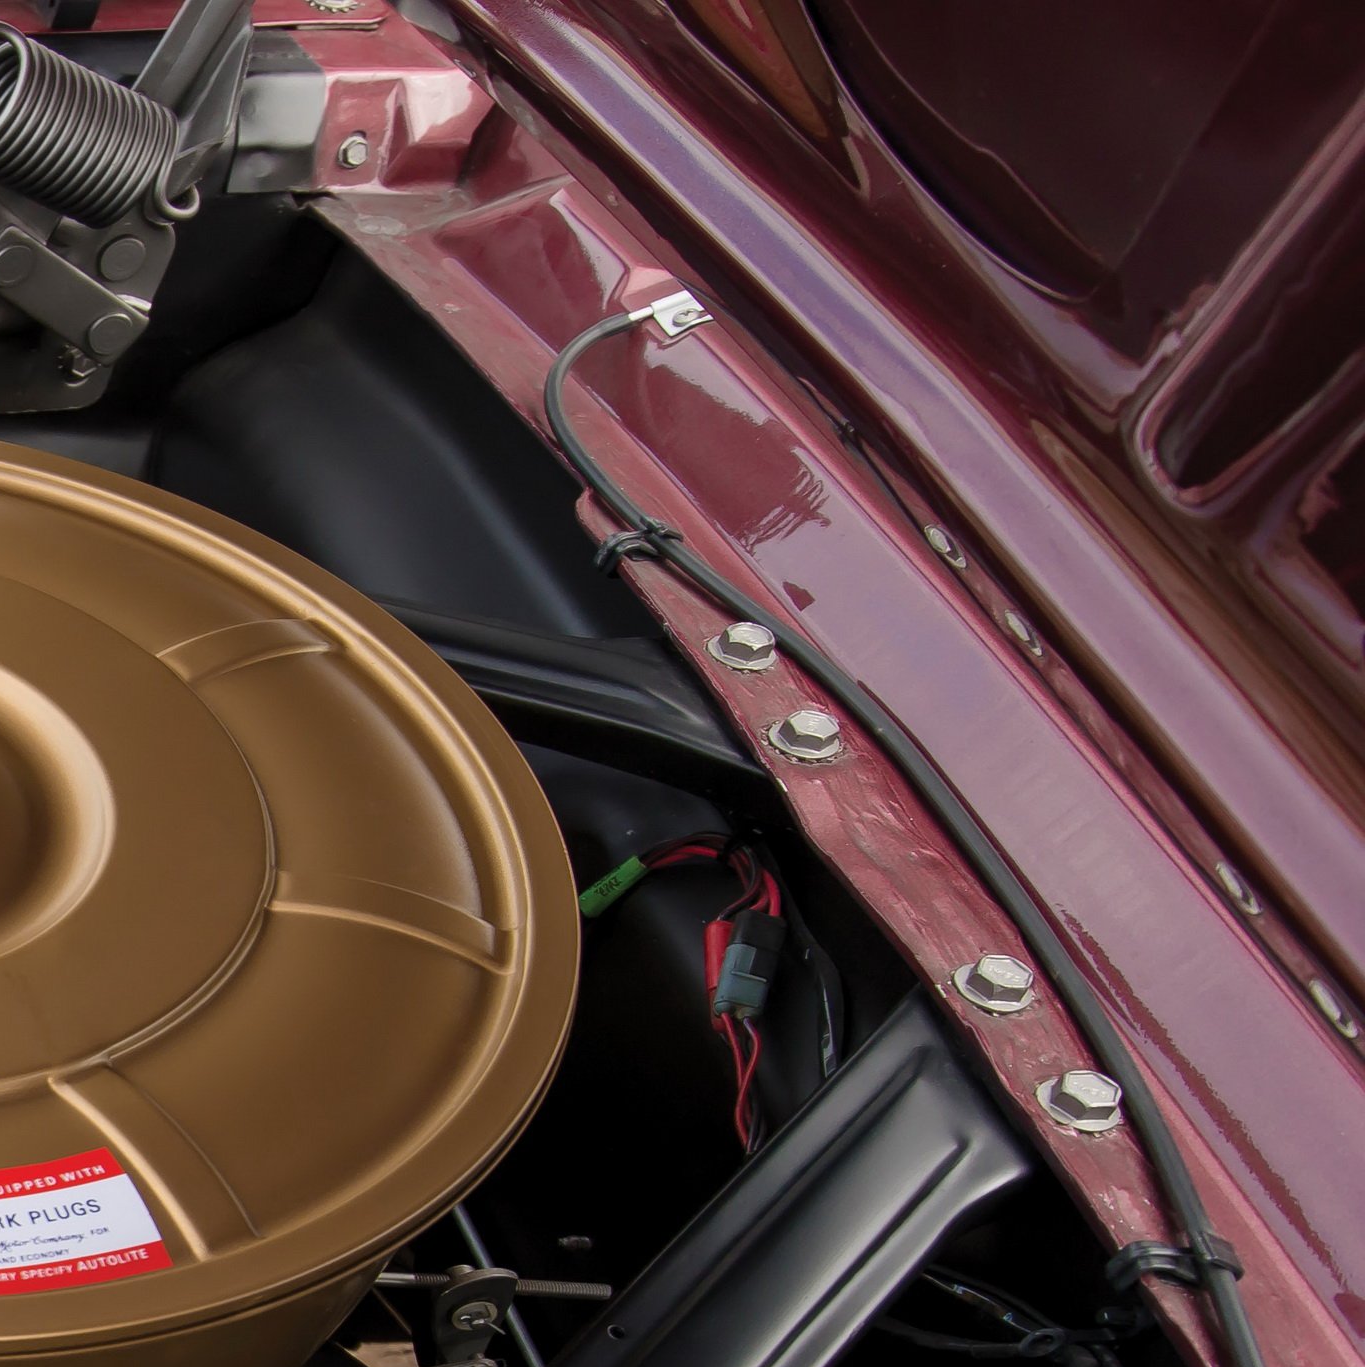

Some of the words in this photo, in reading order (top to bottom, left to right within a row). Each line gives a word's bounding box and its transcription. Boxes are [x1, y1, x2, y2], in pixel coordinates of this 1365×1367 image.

[61, 1164, 105, 1186] WITH
[29, 1198, 102, 1225] PLUGS
[20, 1249, 70, 1263] ECONOMY
[20, 1264, 73, 1280] SPECIFY
[77, 1247, 149, 1272] AUTOLITE
